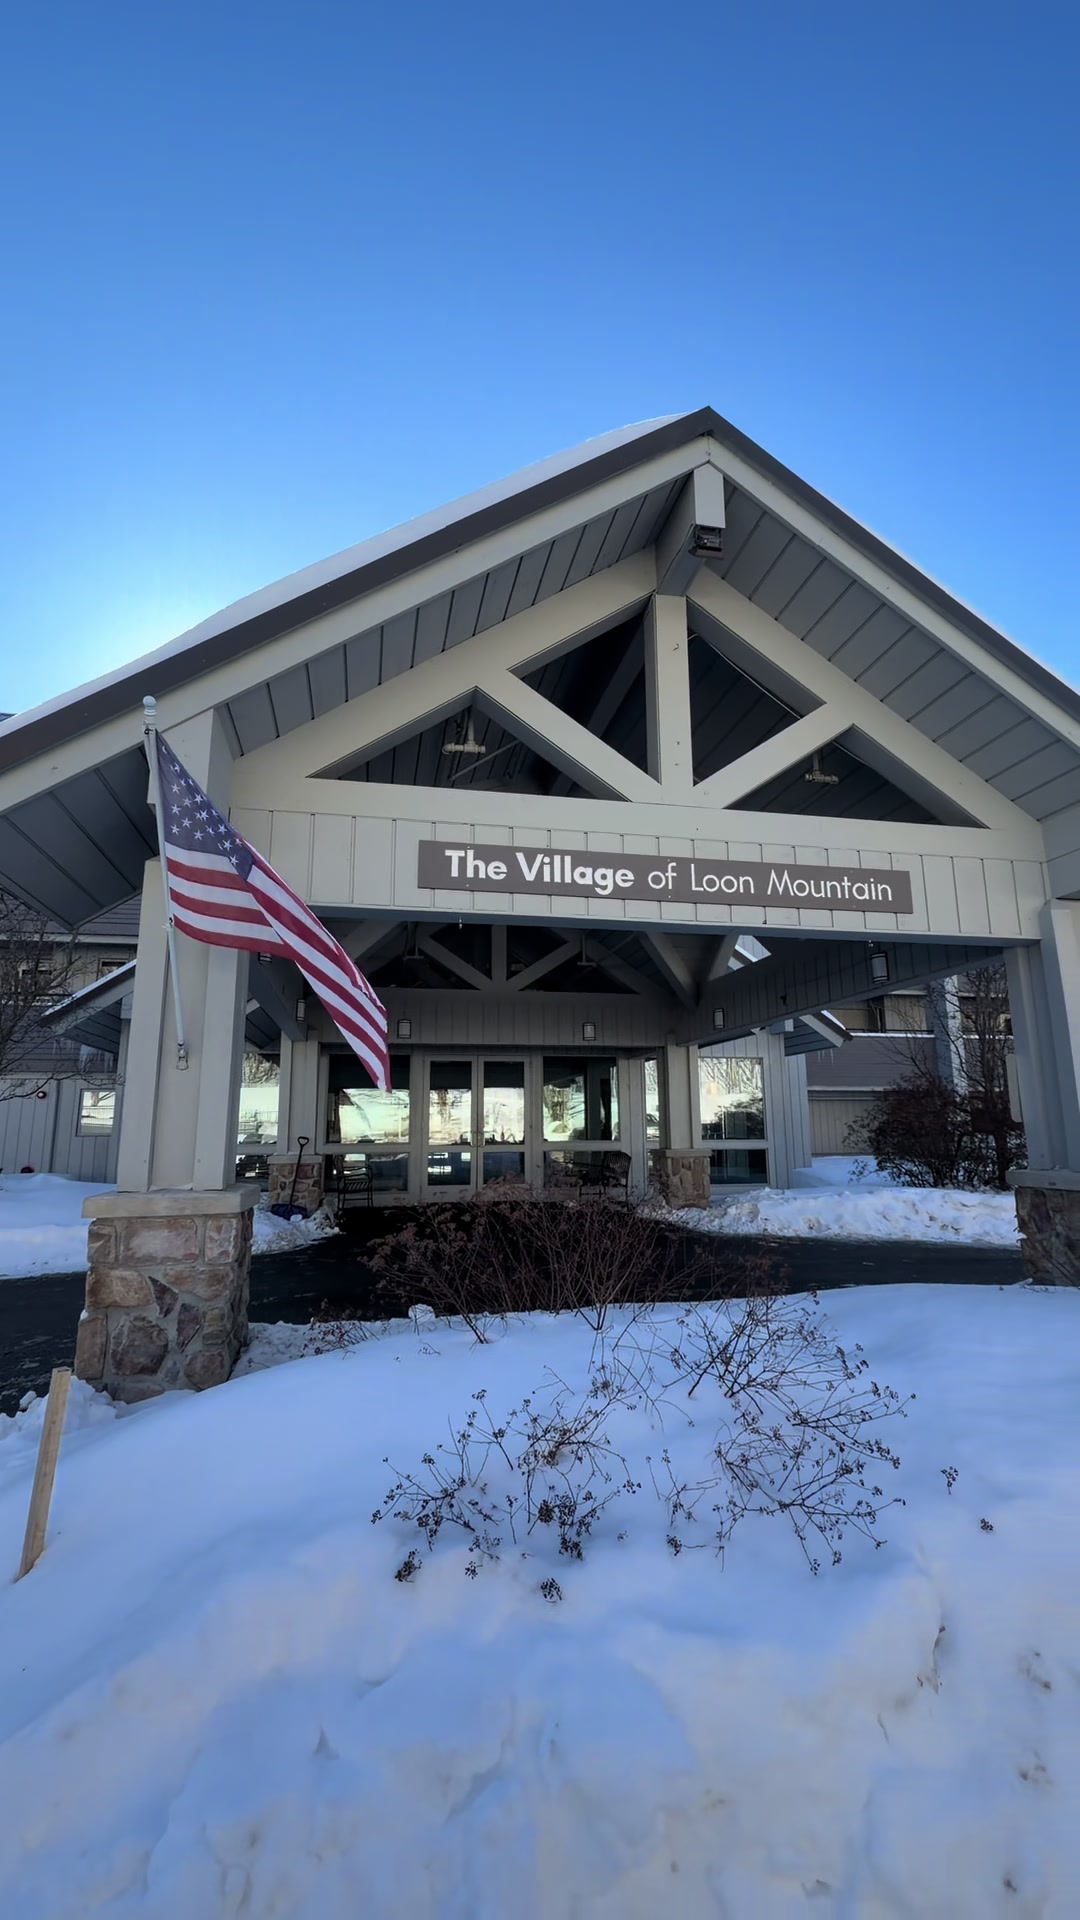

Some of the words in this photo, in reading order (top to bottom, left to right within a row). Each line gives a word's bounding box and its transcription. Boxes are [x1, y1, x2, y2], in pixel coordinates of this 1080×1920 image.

[444, 849, 508, 881] The
[515, 851, 635, 896] Village
[647, 861, 678, 890] of
[690, 863, 755, 895] Loon
[766, 868, 893, 902] Mountain
